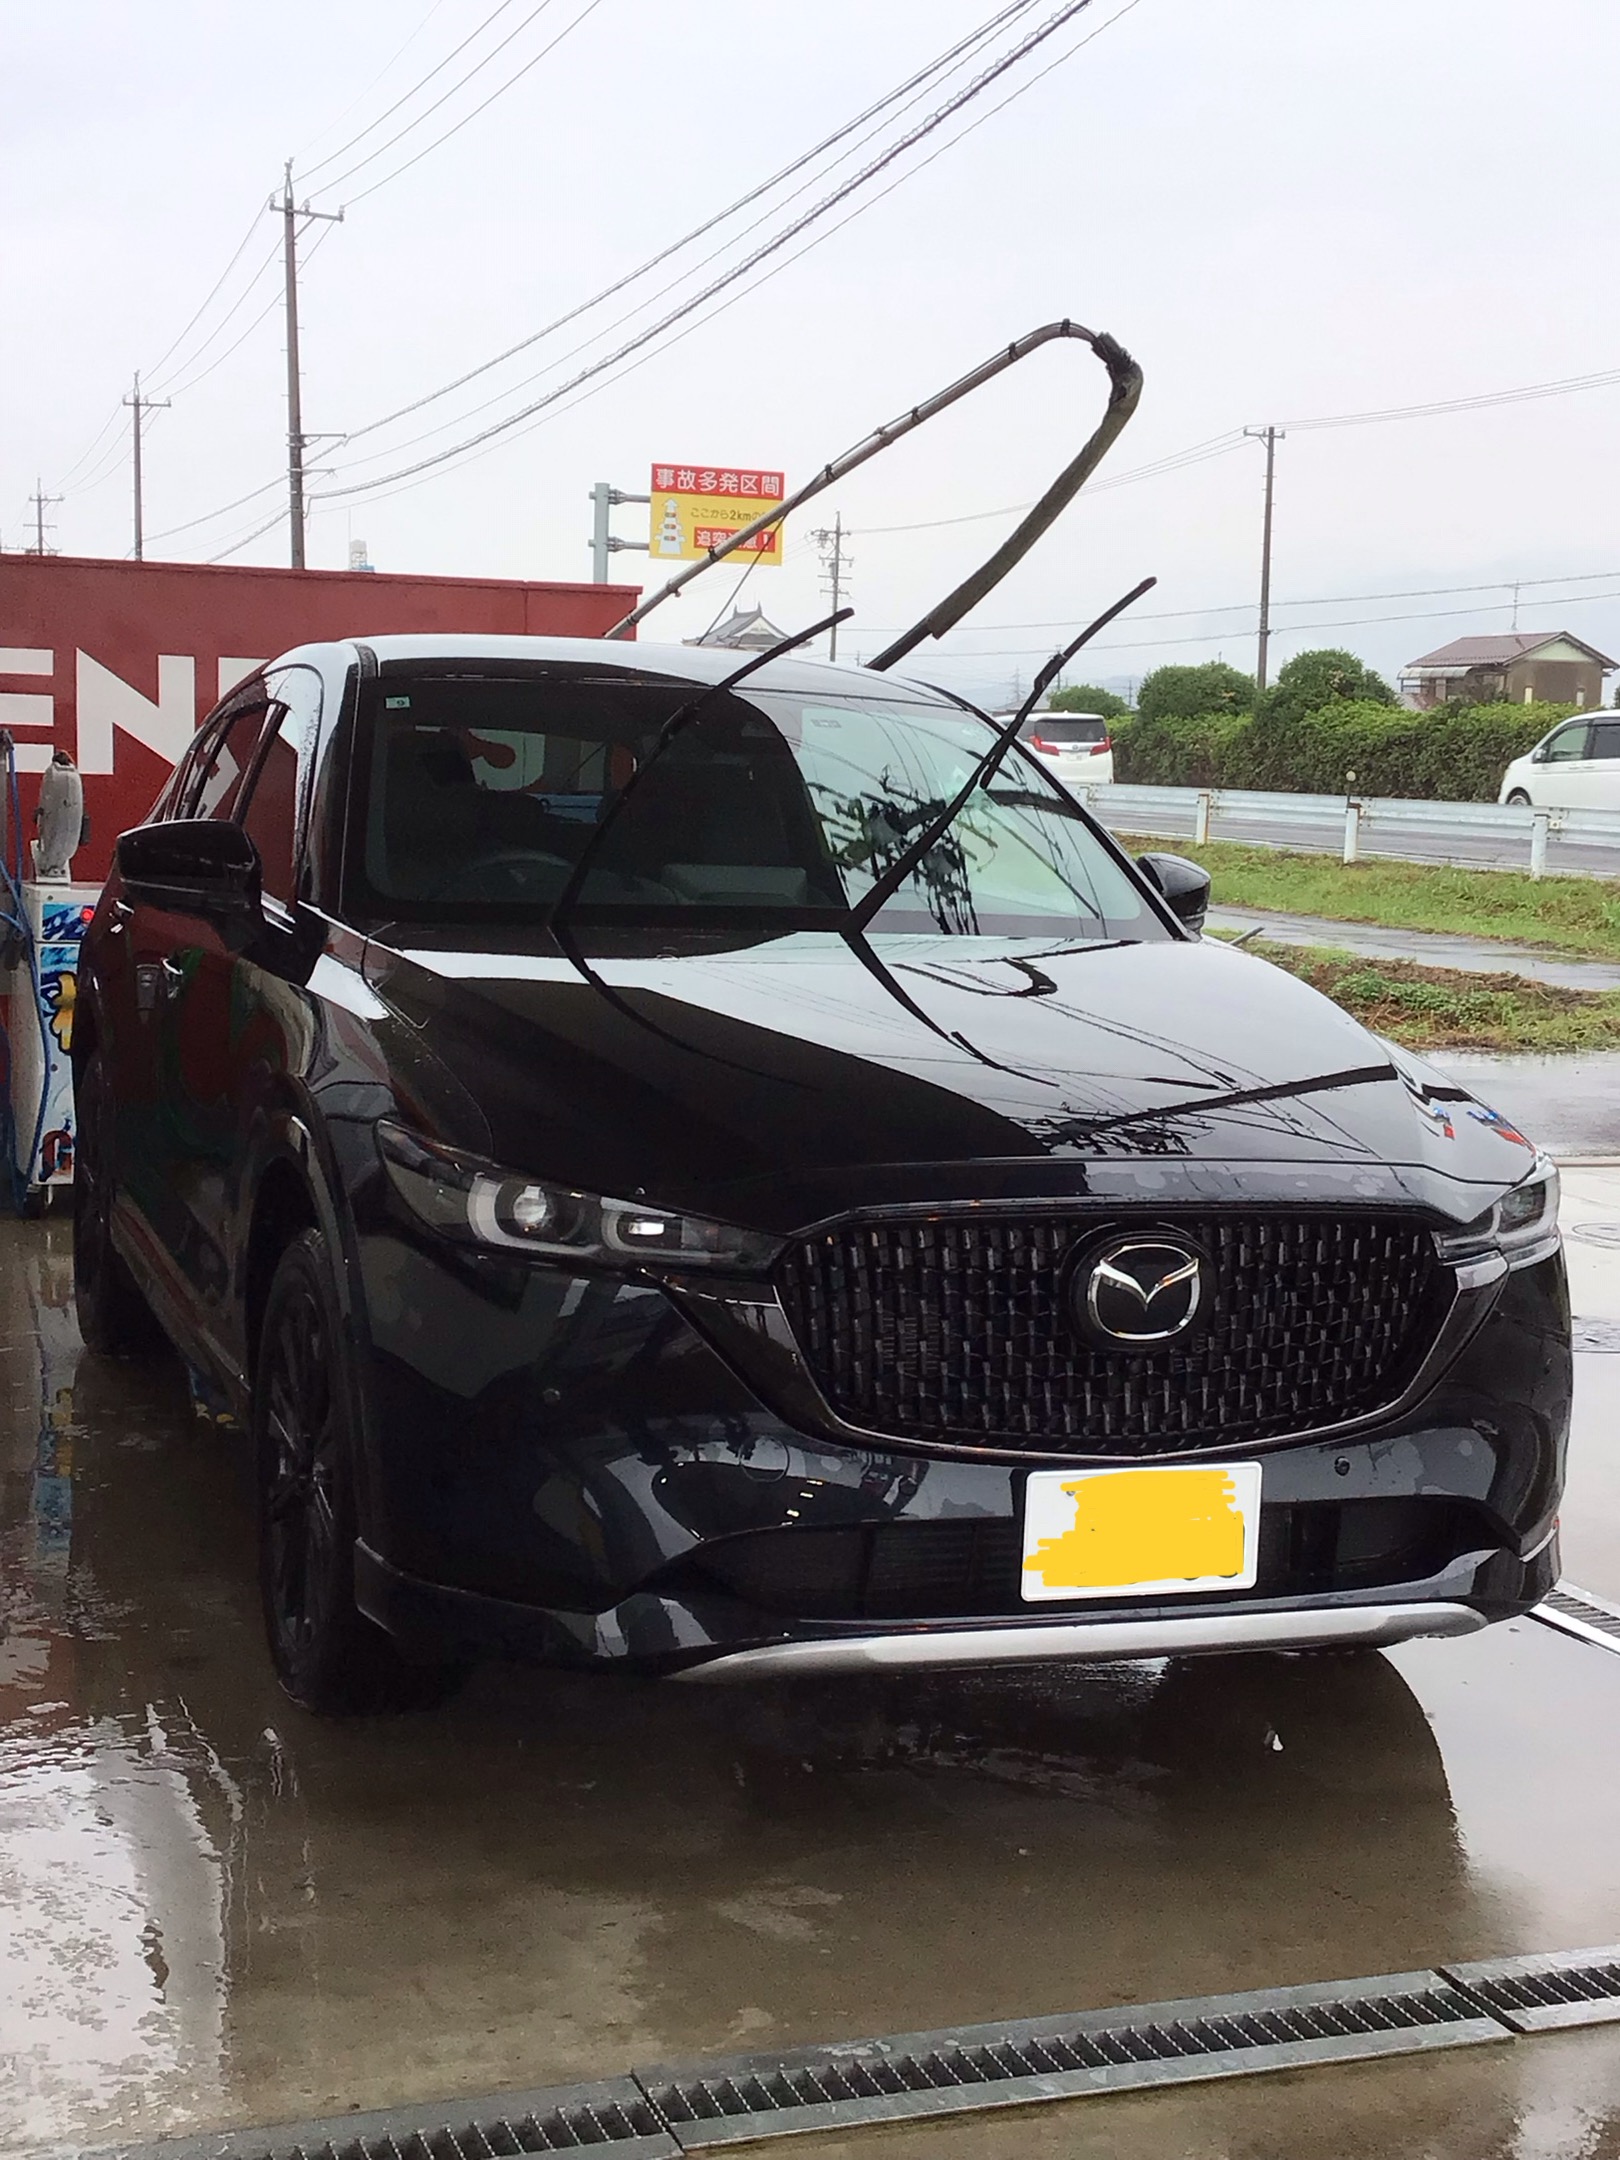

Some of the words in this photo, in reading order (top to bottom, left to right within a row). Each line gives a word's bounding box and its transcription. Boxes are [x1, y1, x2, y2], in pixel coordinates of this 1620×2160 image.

[656, 468, 779, 496] 事故多発区間
[691, 507, 767, 521] ここから2kmの
